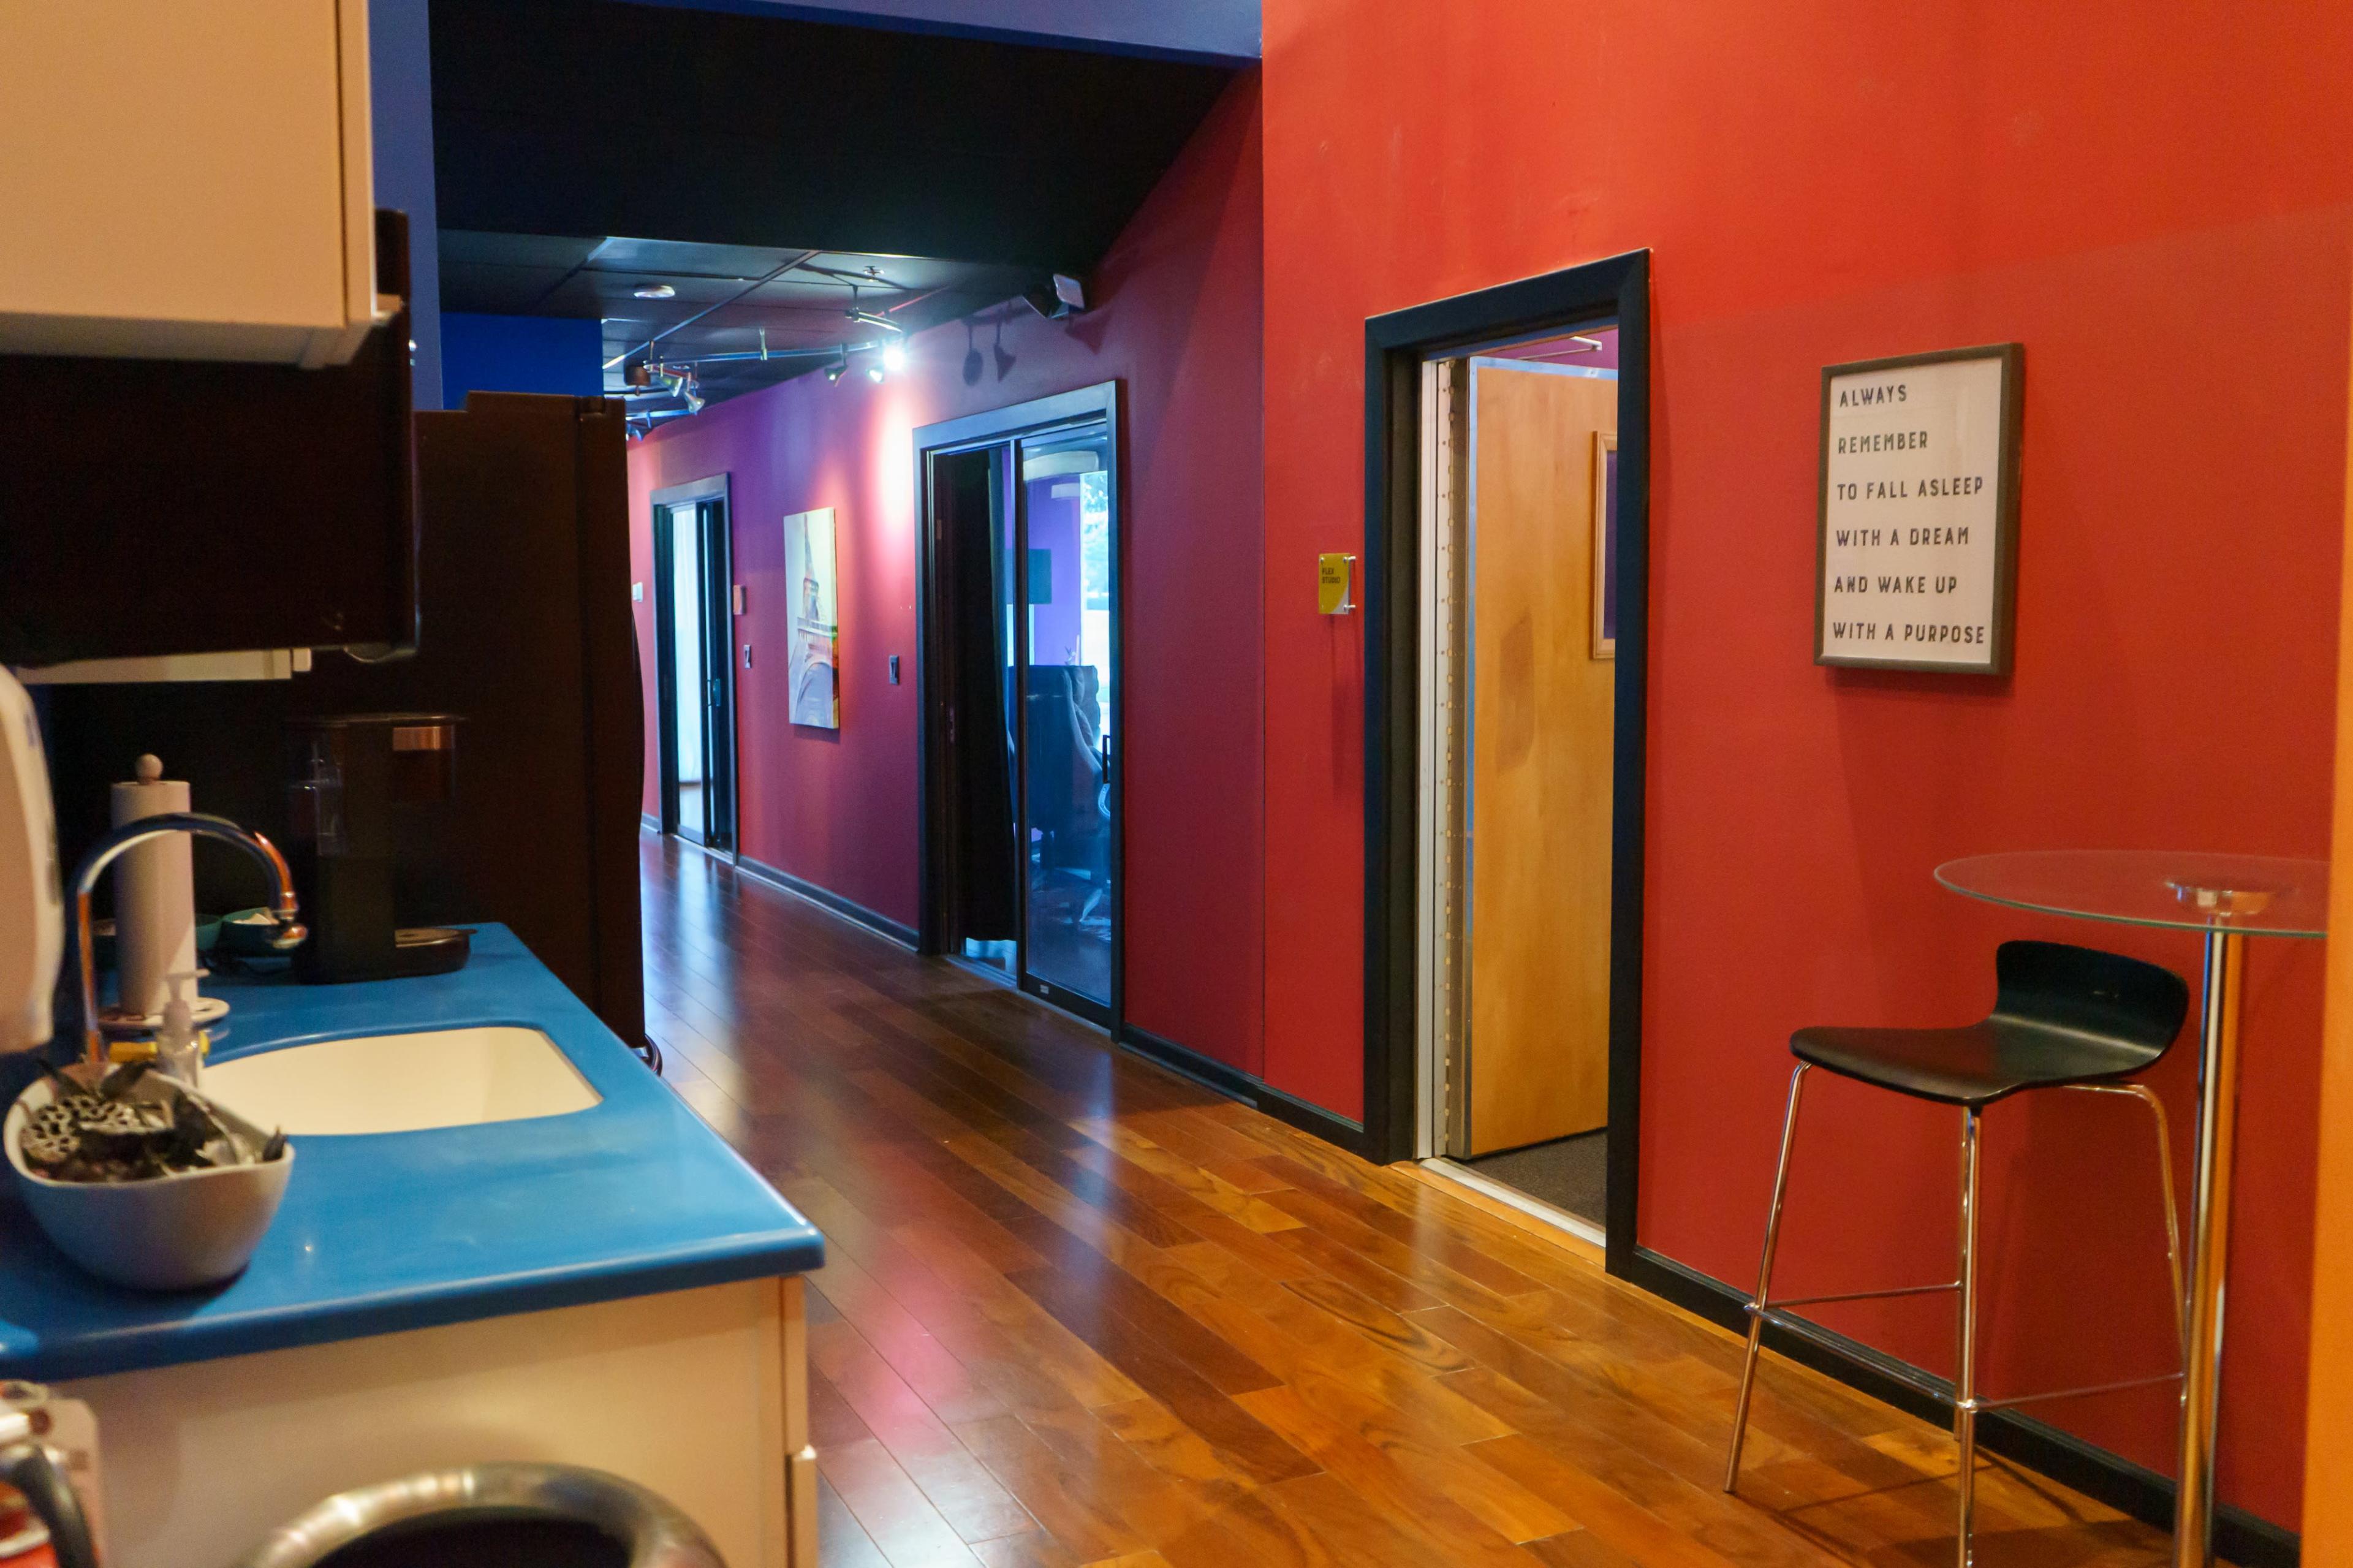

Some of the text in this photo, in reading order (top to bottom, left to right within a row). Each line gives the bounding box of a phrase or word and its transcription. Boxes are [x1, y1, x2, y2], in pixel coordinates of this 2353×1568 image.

[1839, 384, 1906, 407] ALWAYS
[1838, 431, 1928, 454] REMEMBER
[1837, 476, 1983, 501] TO FALL ASLEEP
[1836, 526, 1969, 547] WITH A DREAM
[1834, 576, 1957, 594] AND WAKE UP
[1833, 622, 1984, 644] WITH A PURPOSE
